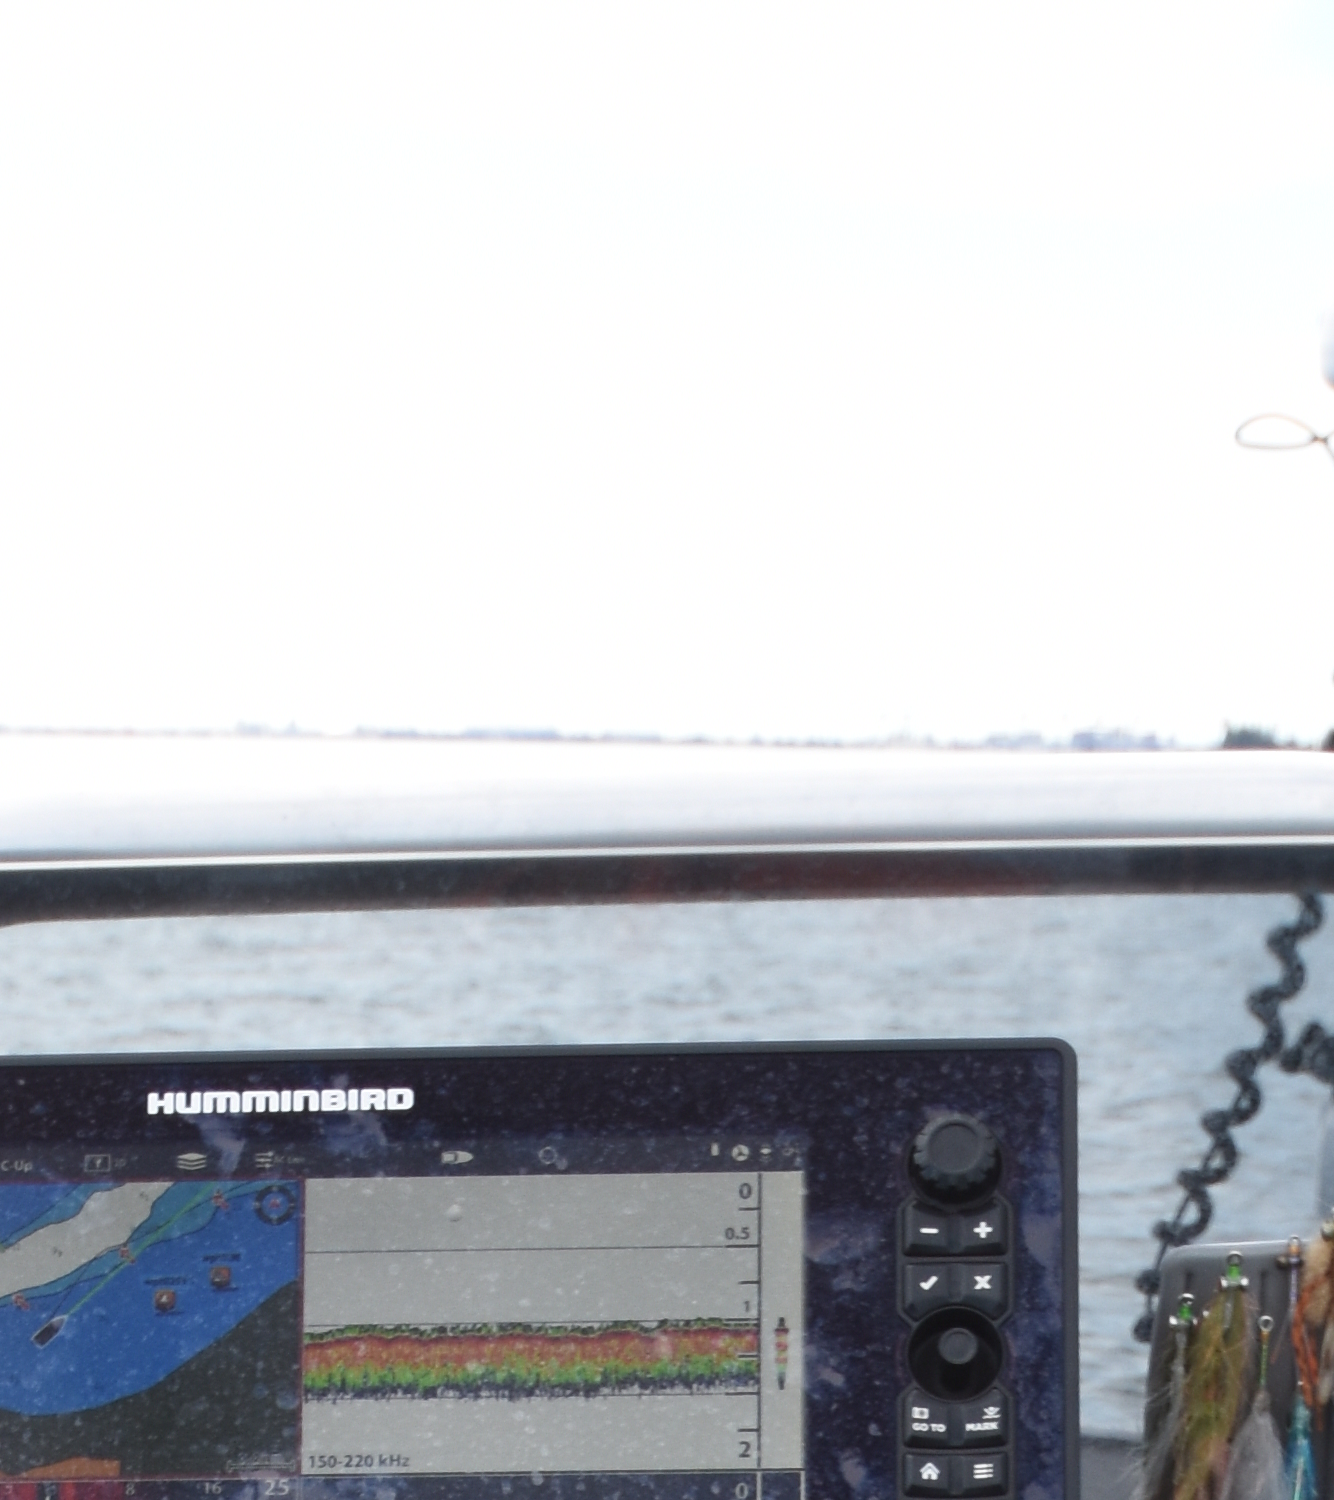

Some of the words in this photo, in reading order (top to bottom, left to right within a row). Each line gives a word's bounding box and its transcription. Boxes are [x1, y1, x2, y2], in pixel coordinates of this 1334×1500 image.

[147, 1088, 414, 1115] HUMMINBIRD
[739, 1183, 752, 1200] 0
[725, 1226, 750, 1241] 0.5
[912, 1423, 929, 1432] GO
[930, 1423, 947, 1432] TO
[965, 1421, 999, 1432] MARK
[738, 1441, 751, 1458] 2
[309, 1455, 374, 1468] 150-220
[378, 1454, 410, 1467] kHz
[265, 1480, 289, 1495] 25
[735, 1482, 748, 1499] 0
